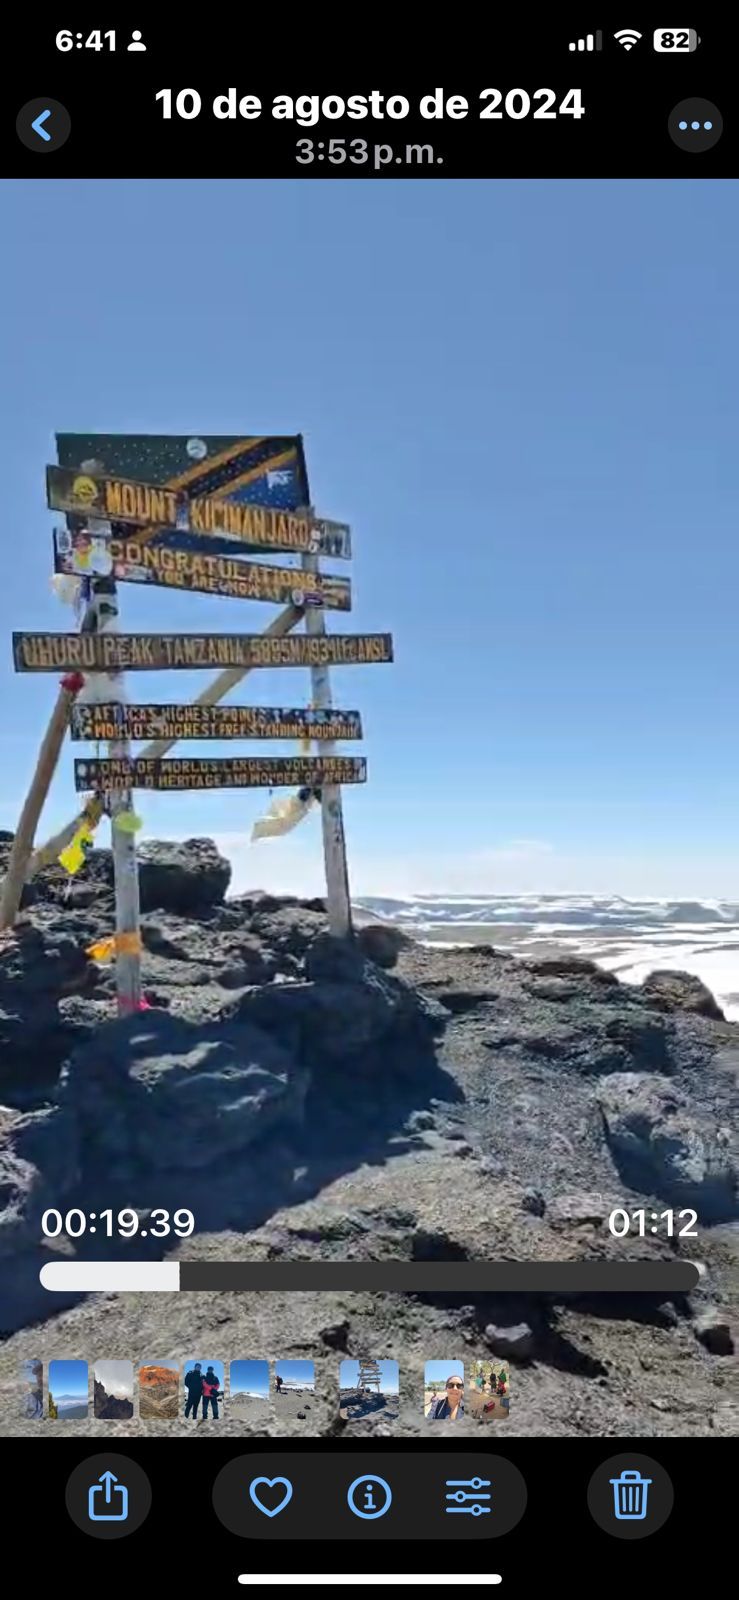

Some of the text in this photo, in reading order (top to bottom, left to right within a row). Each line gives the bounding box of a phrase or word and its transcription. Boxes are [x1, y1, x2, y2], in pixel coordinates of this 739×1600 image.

[104, 480, 177, 523] MOUNT
[108, 540, 316, 590] CONGRATULATIONS
[158, 570, 186, 585] YOU
[192, 574, 218, 591] ARE
[23, 636, 96, 667] UHURU
[103, 637, 153, 666] PEAK
[163, 637, 244, 665] TANZANIA
[161, 706, 216, 722] HIGHEST
[137, 760, 155, 774] OF
[160, 773, 222, 788] HERITAGE
